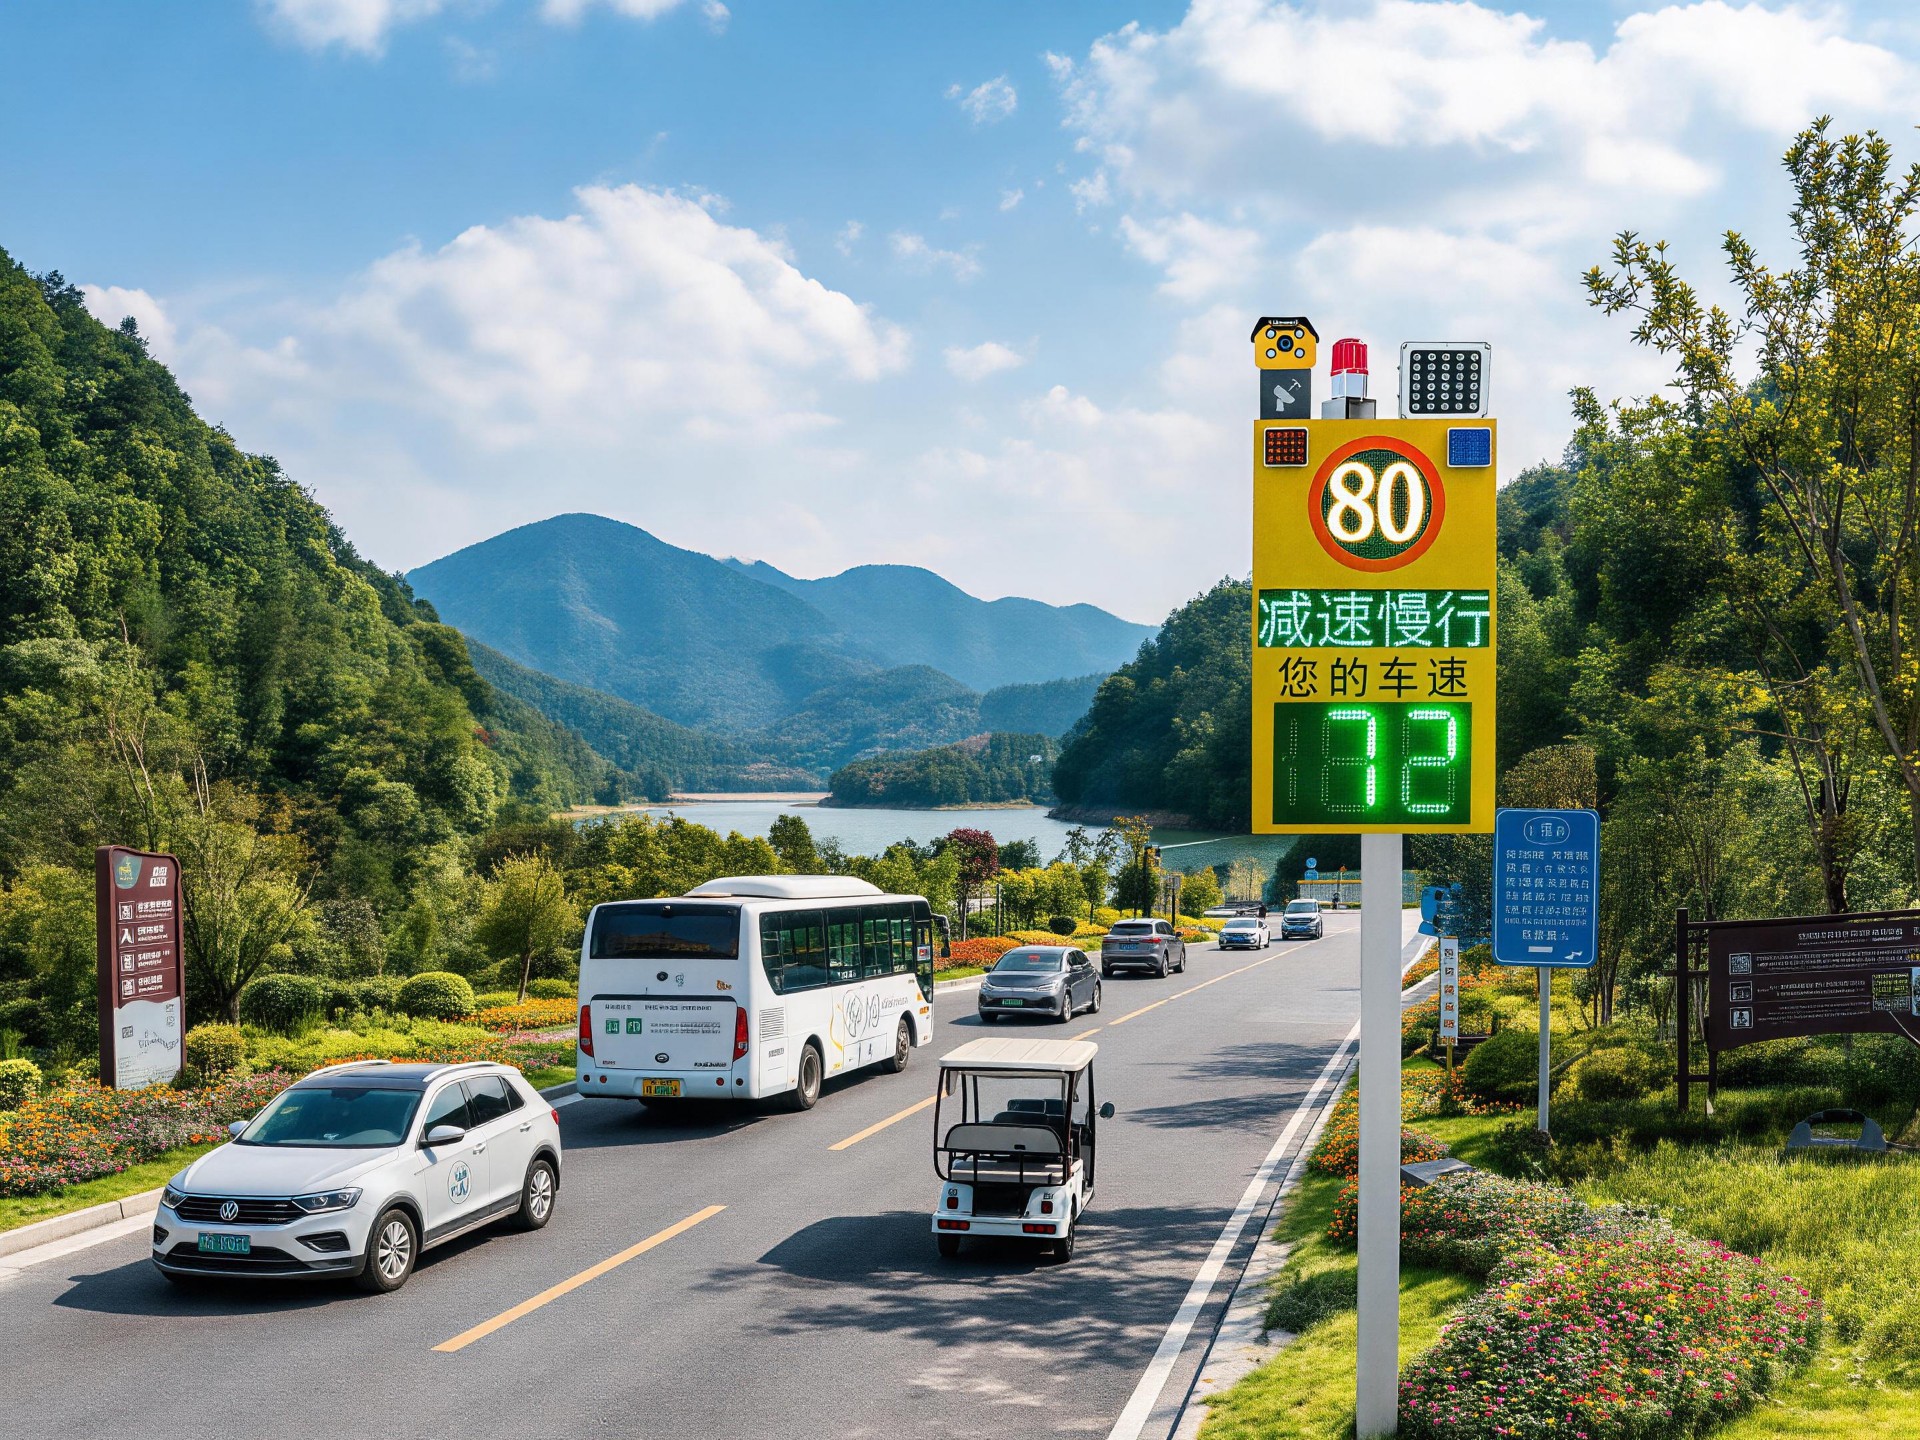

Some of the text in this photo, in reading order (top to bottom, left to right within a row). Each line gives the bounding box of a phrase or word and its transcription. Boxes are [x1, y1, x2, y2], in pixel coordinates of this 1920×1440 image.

[1327, 461, 1424, 543] 80
[1259, 591, 1490, 647] 减速慢行
[1278, 656, 1468, 697] 您的车速
[1327, 709, 1457, 813] 72
